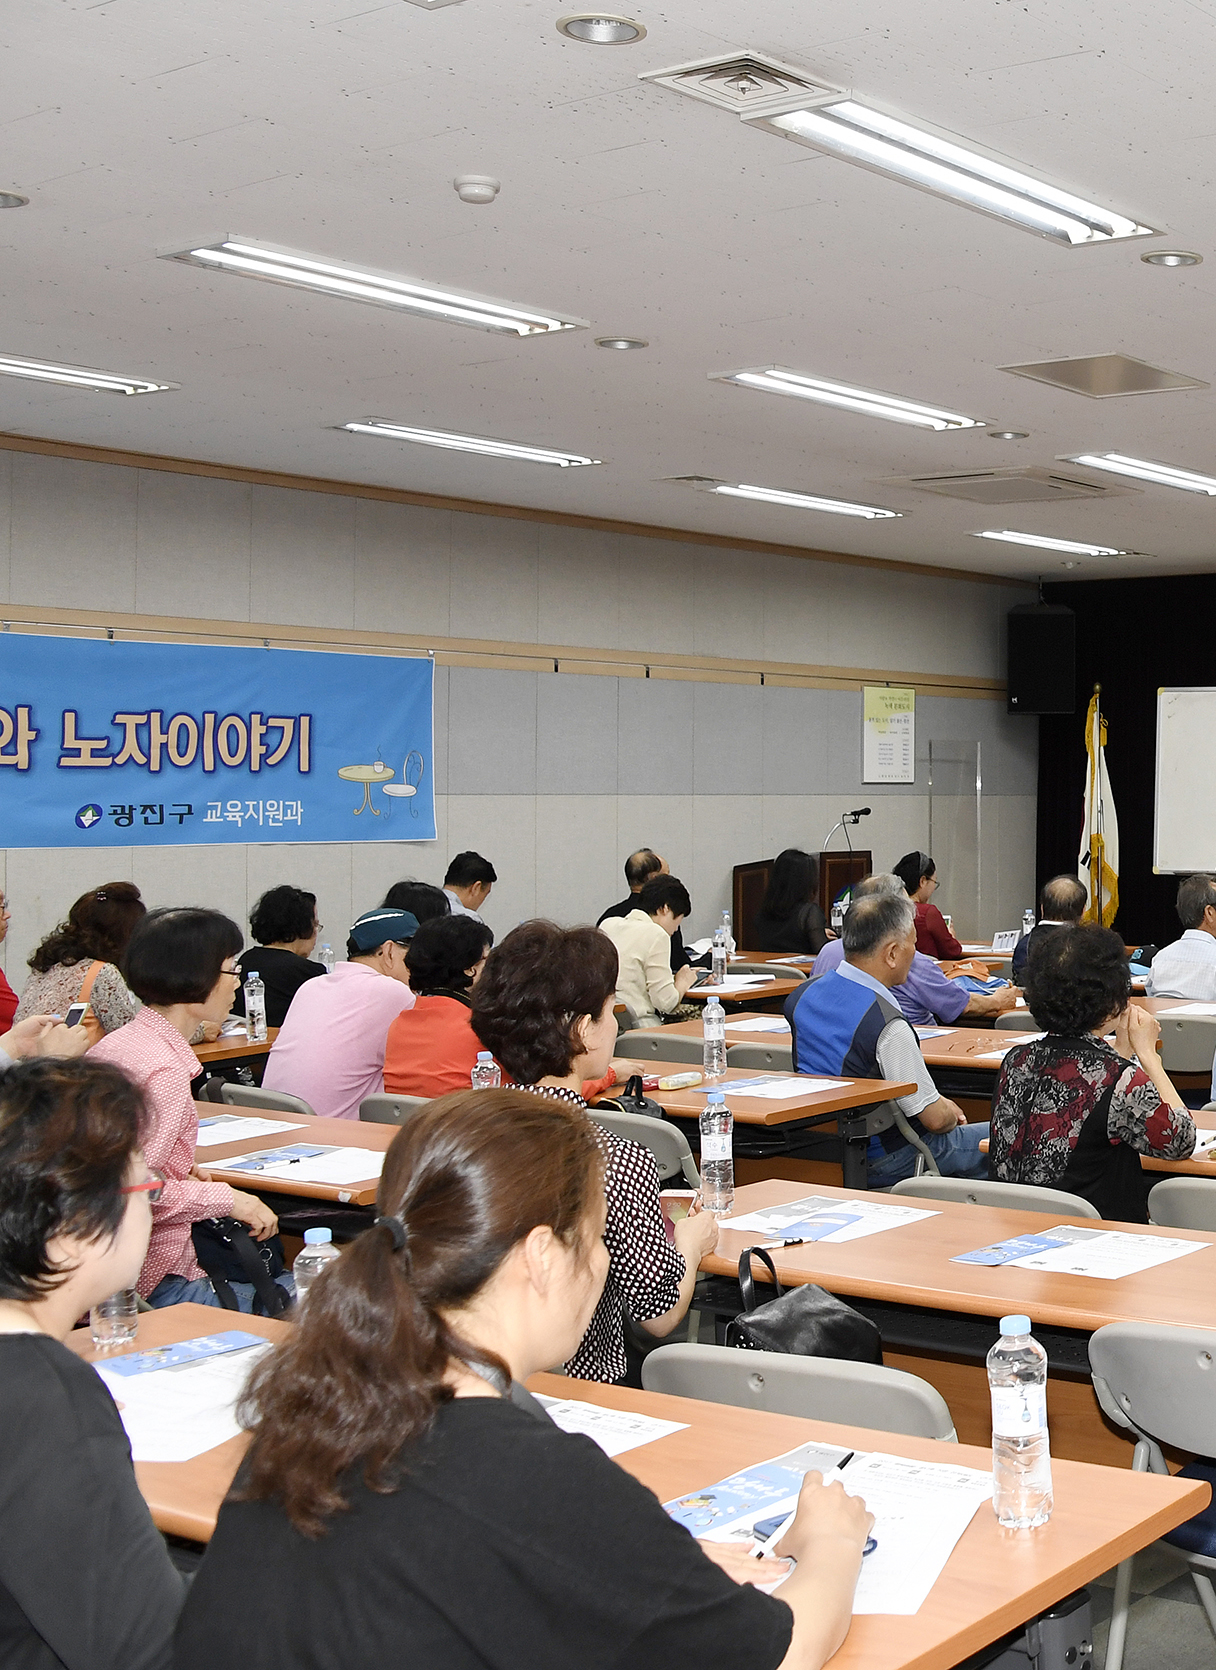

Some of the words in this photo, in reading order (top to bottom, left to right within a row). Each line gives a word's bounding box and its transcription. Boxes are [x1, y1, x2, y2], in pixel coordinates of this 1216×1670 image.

[57, 709, 312, 773] 노자이야기
[107, 803, 195, 827] 광진구
[203, 800, 304, 827] 교육지원과
